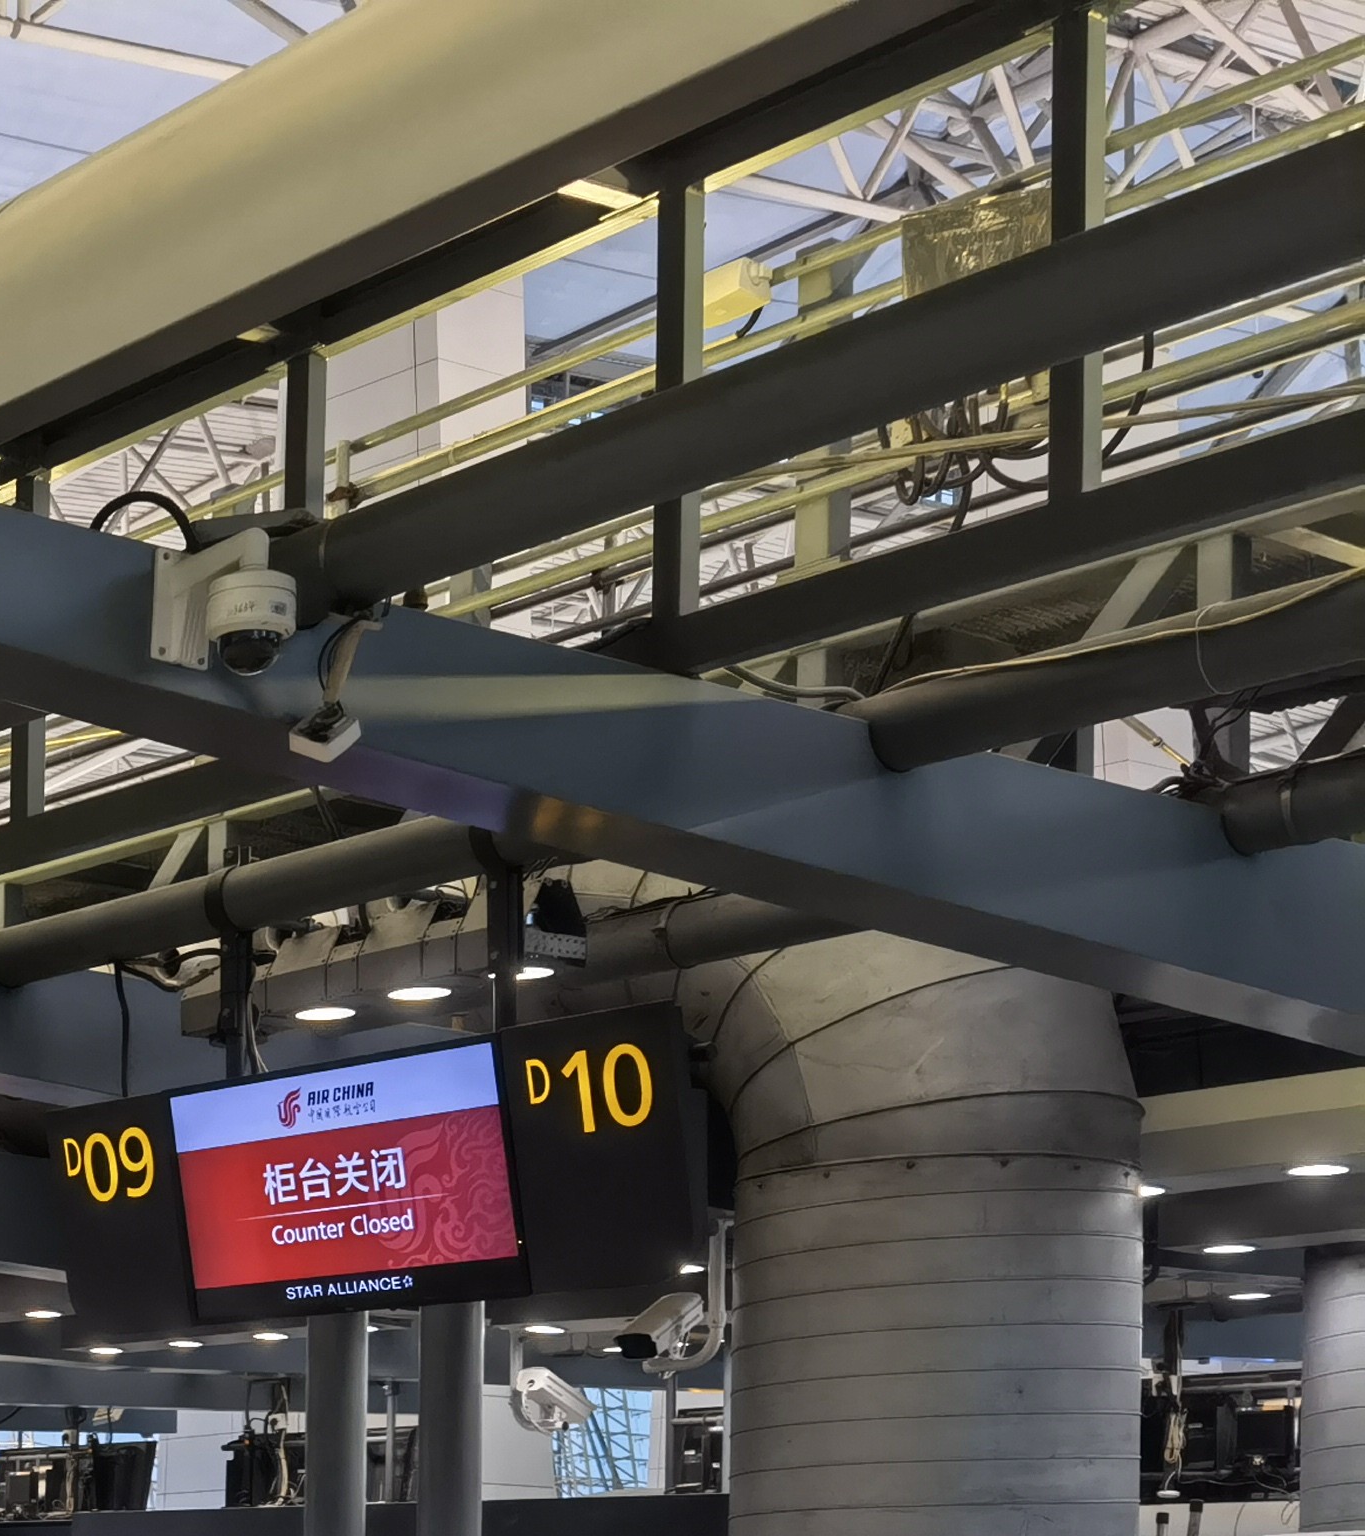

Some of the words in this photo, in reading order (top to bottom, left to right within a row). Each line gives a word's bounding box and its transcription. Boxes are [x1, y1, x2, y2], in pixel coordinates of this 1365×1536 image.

[307, 1088, 335, 1106] AIR
[333, 1081, 374, 1101] CHINA
[525, 1042, 654, 1134] D10
[63, 1126, 155, 1202] D09
[262, 1147, 407, 1206] 柜台关闭
[271, 1221, 345, 1245] Counter
[350, 1208, 414, 1236] Closed
[286, 1284, 323, 1300] STAR
[327, 1276, 402, 1296] ALLIANCE
